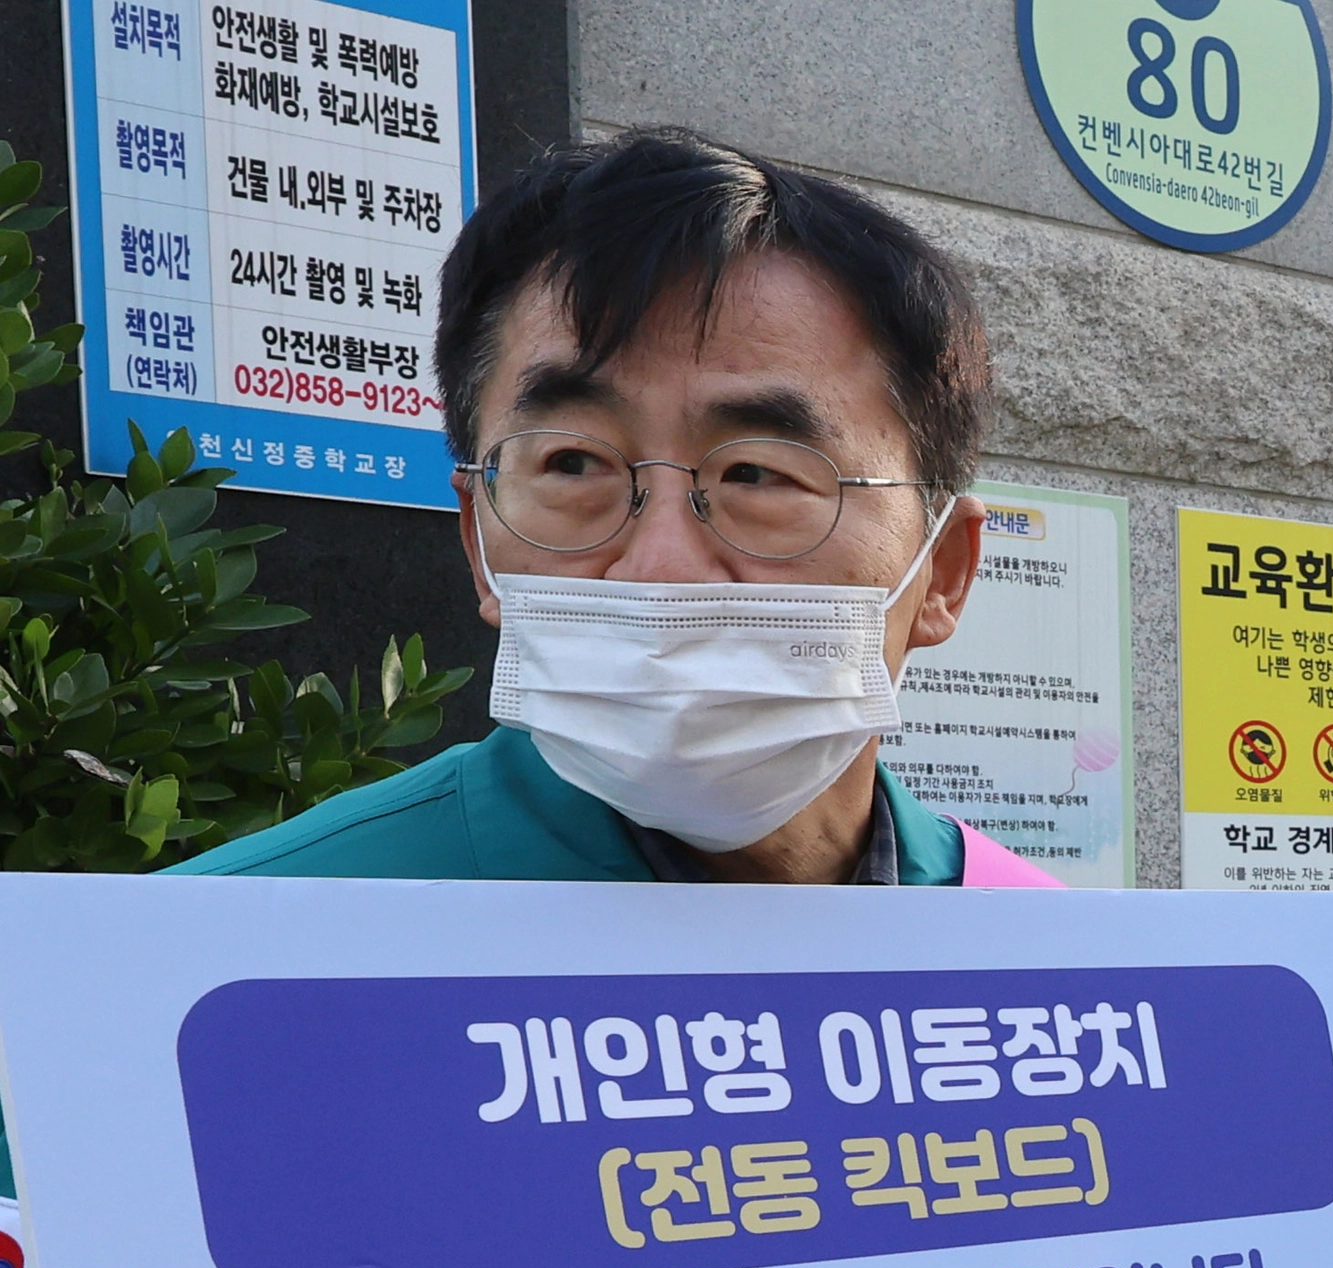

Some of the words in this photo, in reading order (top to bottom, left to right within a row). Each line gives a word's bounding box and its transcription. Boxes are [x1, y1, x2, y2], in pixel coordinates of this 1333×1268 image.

[111, 1, 181, 61] 설치목적
[212, 5, 299, 61] 안전생활
[309, 28, 328, 70] 및
[338, 33, 419, 90] 폭력예방
[1127, 18, 1240, 135] 80
[215, 61, 308, 121] 화재예방,
[318, 82, 440, 144] 학교시설보호
[116, 120, 186, 179] 촬영목적
[1078, 114, 1283, 198] 컨벤시아대로42번길
[227, 156, 268, 202] 건물
[279, 165, 347, 217] 내.외부
[356, 178, 374, 221] 및
[384, 184, 441, 233] 주차장
[1106, 163, 1198, 203] Convensia-daero
[1201, 190, 1259, 219] 42beon-gil
[120, 224, 190, 281] 촬영시간
[231, 249, 297, 297] 24시간
[305, 257, 345, 305] 촬영
[355, 267, 373, 308] 및
[383, 270, 422, 316] 녹화
[125, 307, 194, 351] 책임관
[126, 353, 197, 396] (연락처)
[262, 326, 419, 380] 안전생활부장
[167, 430, 406, 478] 천신정중학교장
[986, 509, 1030, 534] 안내문
[984, 555, 1020, 570] 시설물을
[1022, 558, 1067, 575] 개방하오니
[995, 571, 1022, 585] 주시기
[1024, 575, 1064, 588] 바랍니다.
[790, 640, 856, 662] airdays
[1233, 625, 1284, 650] 여기는
[924, 668, 940, 680] 있는
[943, 669, 976, 682] 경우에는
[979, 672, 1011, 684] 개방하지
[1039, 676, 1046, 687] 수
[1257, 655, 1291, 678] 나쁜
[954, 684, 970, 695] 따라
[973, 685, 1013, 698] 학교시설의
[1016, 687, 1031, 699] 관리
[1033, 688, 1041, 700] 및
[1043, 689, 1074, 701] 이용자의
[915, 722, 932, 734] 또는
[935, 723, 967, 736] 홈페이지
[970, 725, 1050, 740] 학교시설예약시스템을
[1053, 729, 1076, 740] 통하여
[923, 777, 940, 789] 기간
[942, 778, 975, 790] 사용금지
[977, 779, 994, 790] 조치
[936, 764, 970, 776] 다하여야
[1235, 788, 1283, 803] 오염물질
[1021, 820, 1045, 831] 하여야
[1224, 825, 1277, 853] 학교
[1224, 867, 1246, 881] 이를
[1252, 867, 1296, 881] 위반하는
[1302, 868, 1323, 881] 자는
[467, 1012, 792, 1123] 개인형
[819, 1001, 1168, 1105] 이동장치
[598, 1140, 820, 1248] (전동
[841, 1118, 1110, 1220] 킥보드)
